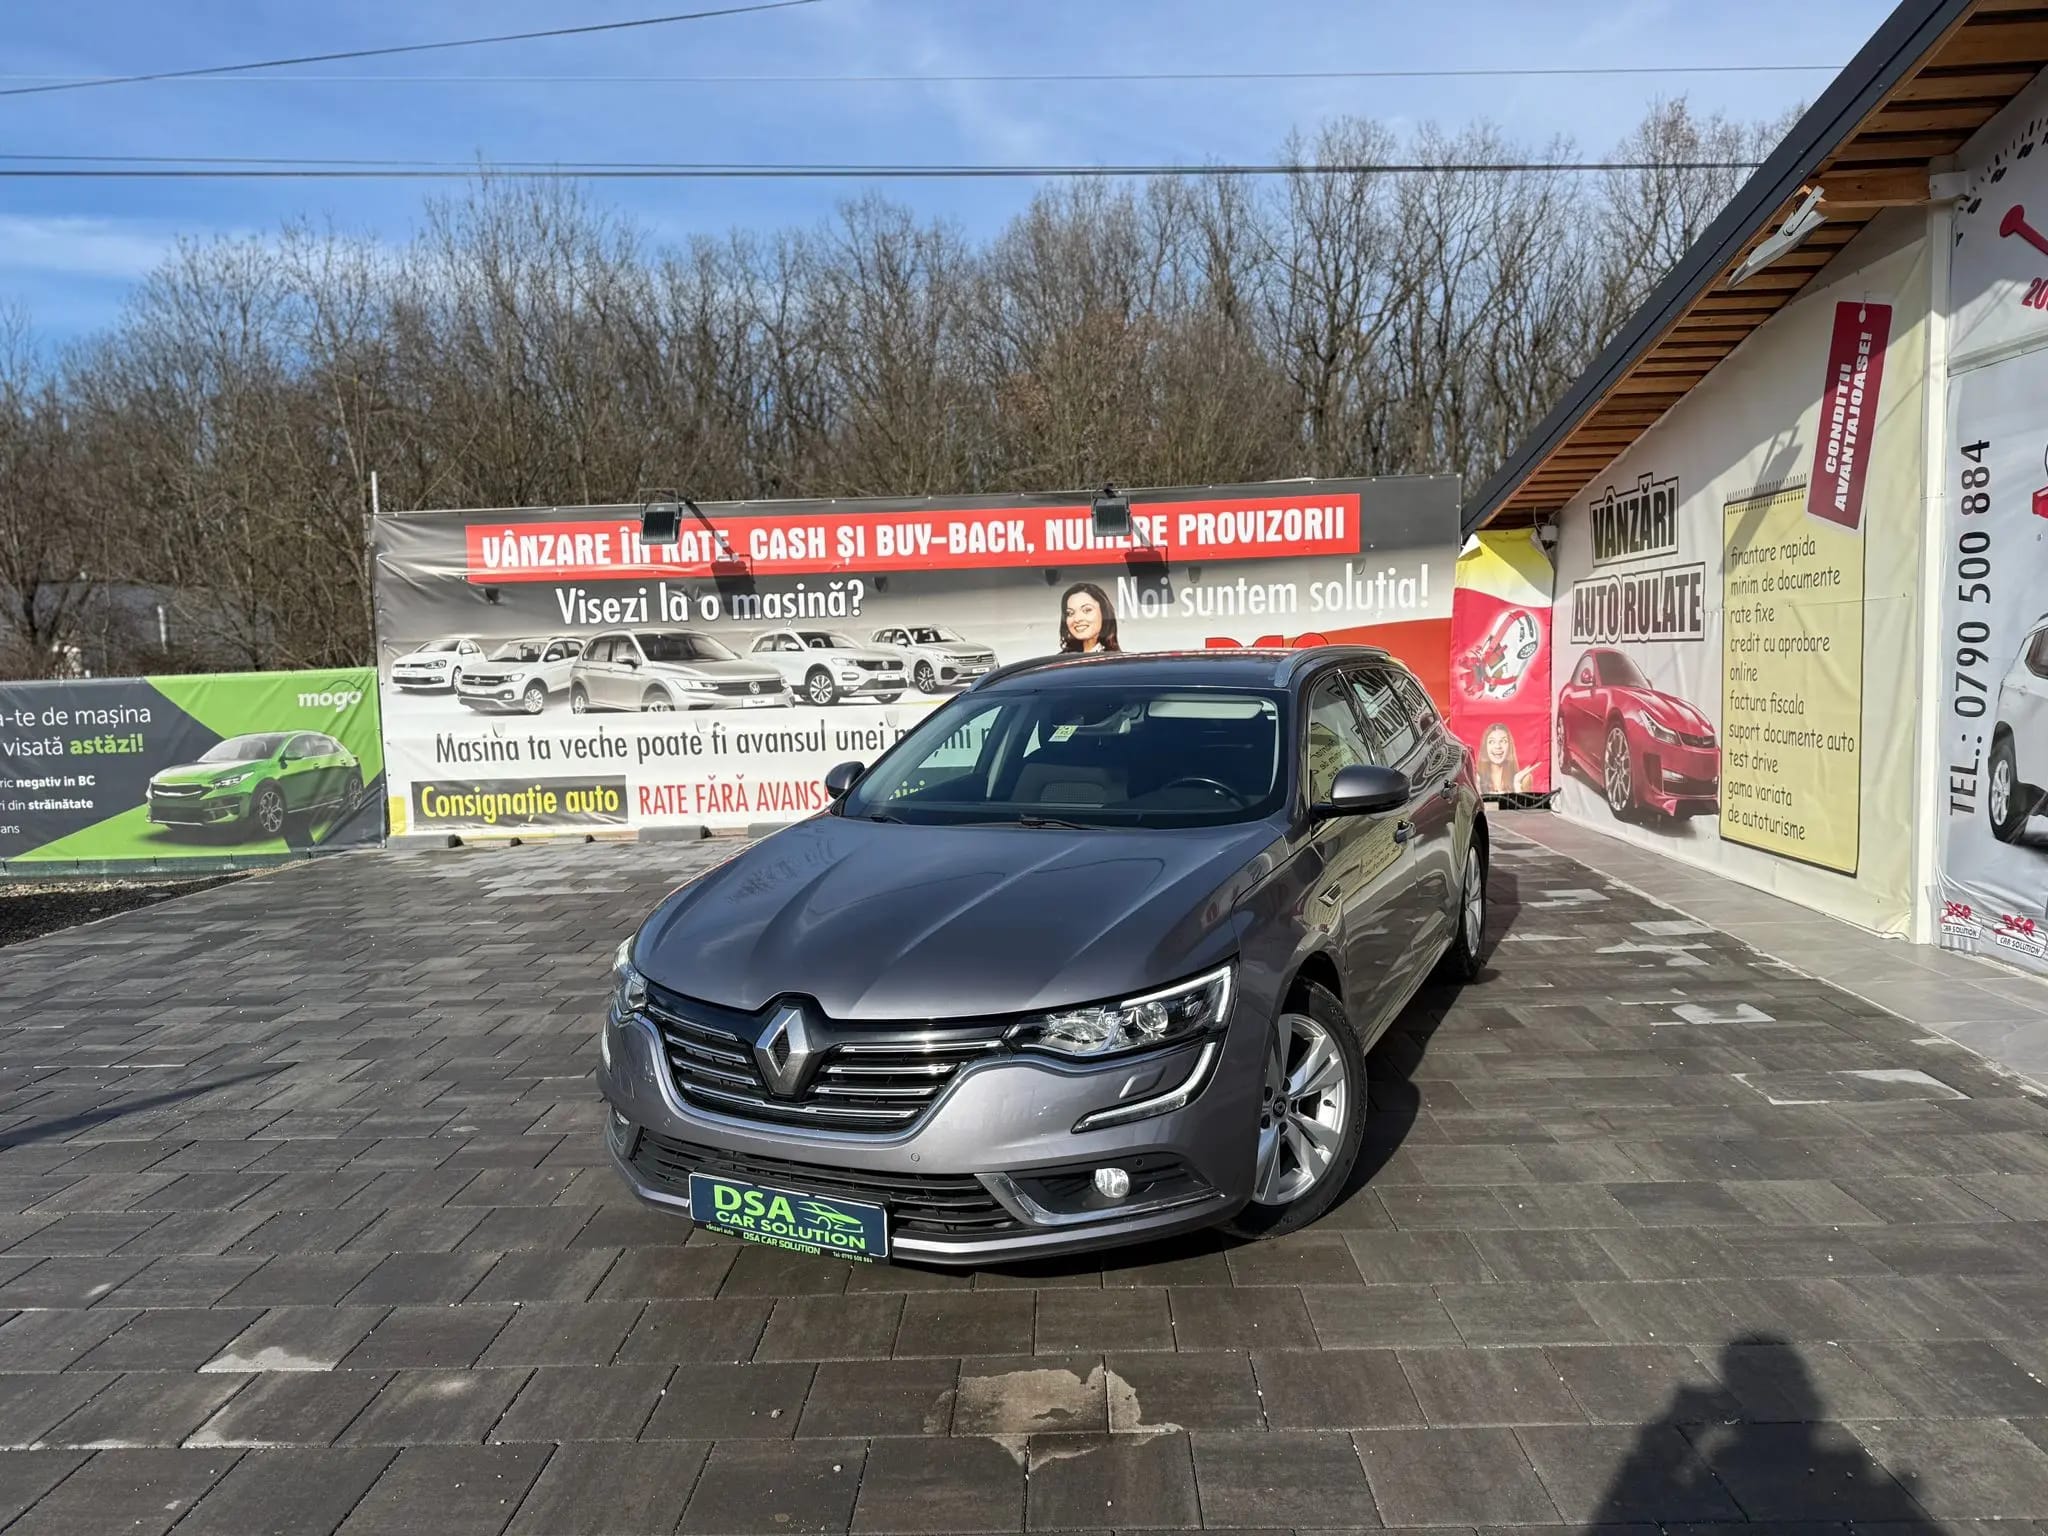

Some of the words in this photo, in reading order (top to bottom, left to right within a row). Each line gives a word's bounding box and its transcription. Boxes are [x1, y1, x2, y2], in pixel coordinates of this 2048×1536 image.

[2021, 277, 2048, 311] 20
[1835, 332, 1872, 512] AVANTAJOASE!
[1961, 440, 1991, 516] 884
[482, 529, 611, 568] VÂNZARE
[750, 527, 826, 560] CASH
[837, 526, 865, 565] ȘI
[876, 520, 1034, 556] BUY-BACK,
[1179, 506, 1344, 546] PROVIZORII
[1593, 483, 1675, 560] VÂNZĂRI
[1731, 546, 1776, 567] finantare
[1780, 534, 1816, 564] rapida
[1958, 531, 1991, 604] 500
[1118, 576, 1168, 619] Noi
[1180, 576, 1297, 618] suntem
[1310, 563, 1429, 618] soluția!
[1730, 576, 1759, 595] minim
[1762, 571, 1775, 592] de
[1778, 566, 1841, 591] documente
[555, 587, 648, 624] Visezi
[659, 582, 690, 622] la
[701, 594, 720, 621] o
[732, 579, 864, 626] mașină?
[1574, 583, 1620, 637] AUTO
[1624, 572, 1701, 635] RULATE
[1730, 606, 1751, 624] rate
[1755, 602, 1775, 624] fixe
[1730, 632, 1760, 653] credit
[1764, 638, 1775, 652] cu
[1778, 630, 1831, 658] aprobare
[1730, 662, 1758, 682] online
[1954, 621, 1990, 718] 0790
[41, 706, 69, 726] de
[75, 704, 151, 728] mașina
[297, 690, 363, 713] mogo
[1729, 689, 1767, 712] factura
[1770, 692, 1805, 715] fiscala
[3, 736, 63, 756] visată
[70, 733, 144, 755] astăzi!
[528, 735, 551, 760] ta
[560, 726, 627, 759] veche
[636, 730, 703, 764] poate
[712, 721, 728, 755] fi
[736, 719, 827, 754] avansul
[836, 721, 886, 750] unei
[1729, 723, 1760, 744] suport
[1763, 722, 1823, 749] documente
[1827, 732, 1855, 752] auto
[1729, 749, 1749, 768] test
[1752, 750, 1778, 773] drive
[16, 776, 61, 790] negativ
[64, 776, 75, 786] in
[78, 775, 96, 786] BC
[639, 784, 687, 815] RATE
[695, 774, 749, 813] FĂRĂ
[1728, 781, 1752, 799] gama
[1755, 784, 1792, 806] variata
[8, 800, 25, 811] din
[28, 799, 94, 811] străinătate
[421, 784, 557, 823] Consignație
[566, 785, 619, 812] auto
[1728, 803, 1740, 823] de
[1742, 811, 1805, 840] autoturisme
[713, 1184, 795, 1223] DSA
[716, 1211, 755, 1229] CAR
[760, 1218, 866, 1249] SOLUTION
[743, 1231, 760, 1243] DSA
[761, 1236, 778, 1246] CAR
[779, 1240, 821, 1255] SOLUTION
